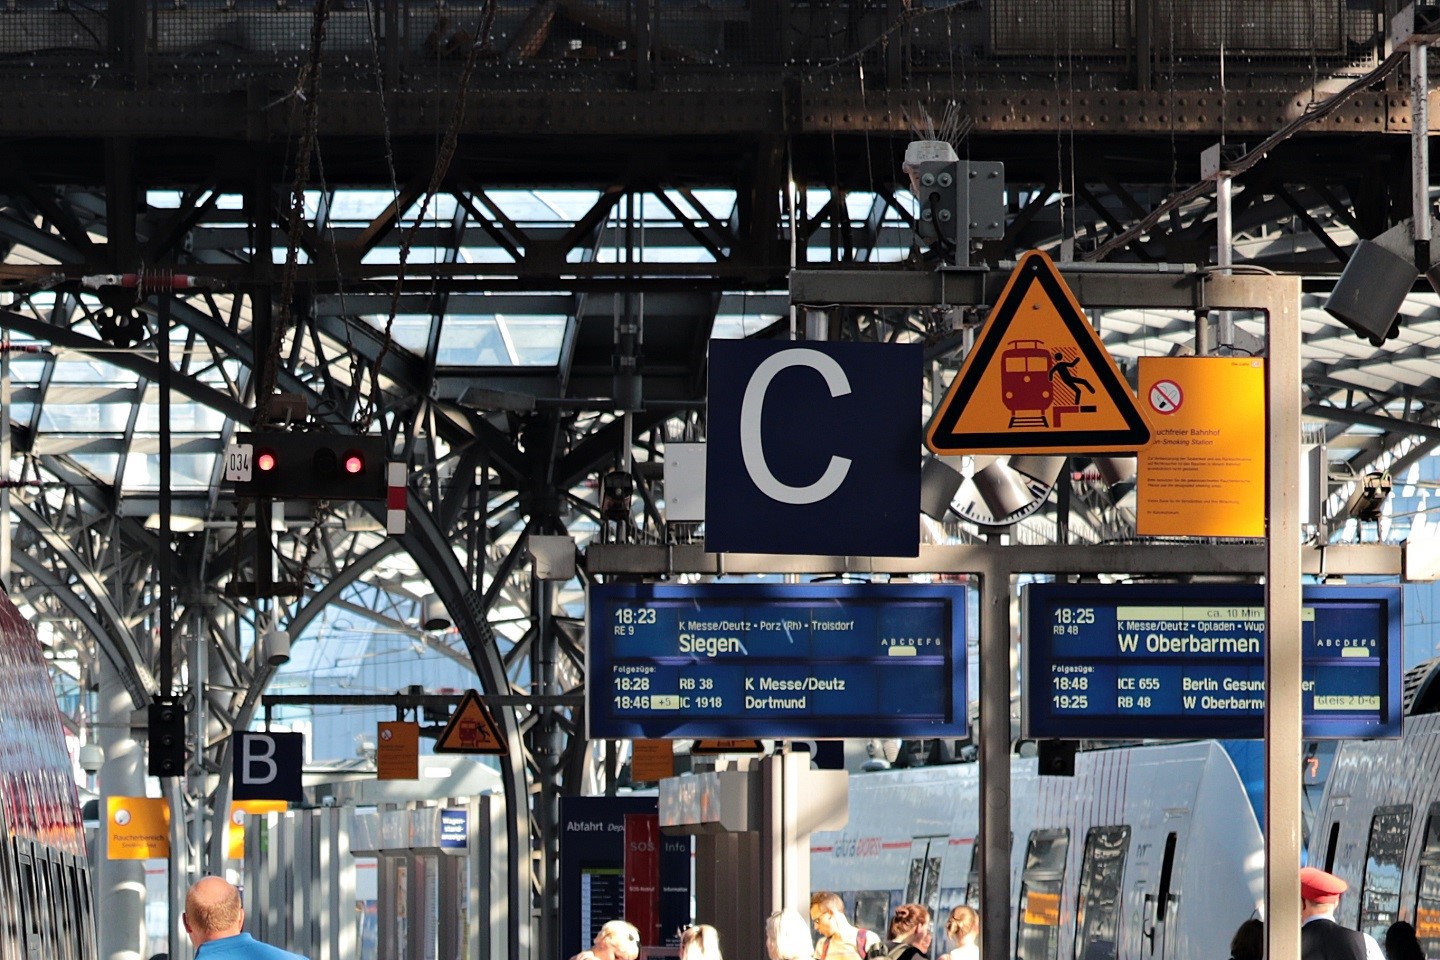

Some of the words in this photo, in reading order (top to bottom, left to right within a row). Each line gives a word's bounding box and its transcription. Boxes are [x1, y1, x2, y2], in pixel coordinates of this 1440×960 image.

[739, 347, 853, 506] C
[230, 453, 249, 472] 034
[615, 608, 657, 624] 18:23
[1054, 608, 1095, 624] 18:25
[1207, 609, 1223, 618] ca.
[1241, 609, 1261, 618] Min
[614, 626, 626, 635] RE
[628, 626, 635, 635] 9
[679, 621, 686, 631] K
[688, 621, 751, 631] Messe/Deutz
[760, 622, 781, 631] Porz
[812, 621, 854, 631] Troisdorf
[1053, 625, 1065, 635] RB
[1067, 625, 1079, 635] 48
[1118, 621, 1124, 631] K
[1126, 621, 1189, 631] Messe/Deutz
[1198, 621, 1235, 632] Opladen
[1244, 622, 1265, 633] Wup
[679, 633, 739, 657] Siegen
[1117, 633, 1139, 652] W
[1146, 633, 1260, 653] Oberbarmen
[613, 665, 657, 675] Folgezüge:
[1052, 664, 1095, 674] Folgezüge:
[614, 677, 650, 691] 18:28
[680, 678, 695, 690] RB
[699, 678, 713, 690] 38
[745, 677, 755, 691] K
[760, 677, 845, 691] Messe/Deutz
[1053, 677, 1088, 690] 18:48
[1118, 678, 1135, 690] ICE
[1139, 678, 1160, 690] 655
[1183, 677, 1218, 691] Berlin
[614, 696, 650, 709] 18:46
[680, 697, 691, 708] IC
[695, 696, 723, 709] 1918
[745, 696, 806, 709] Dortmund
[1053, 695, 1088, 709] 19:25
[1118, 696, 1133, 708] RB
[1137, 696, 1151, 708] 48
[1183, 696, 1196, 709] W
[1318, 696, 1345, 705] Gleis
[1348, 696, 1355, 705] 2
[242, 734, 278, 785] B
[566, 821, 604, 832] Abfahrt
[631, 841, 655, 852] SOS
[665, 842, 686, 853] Info
